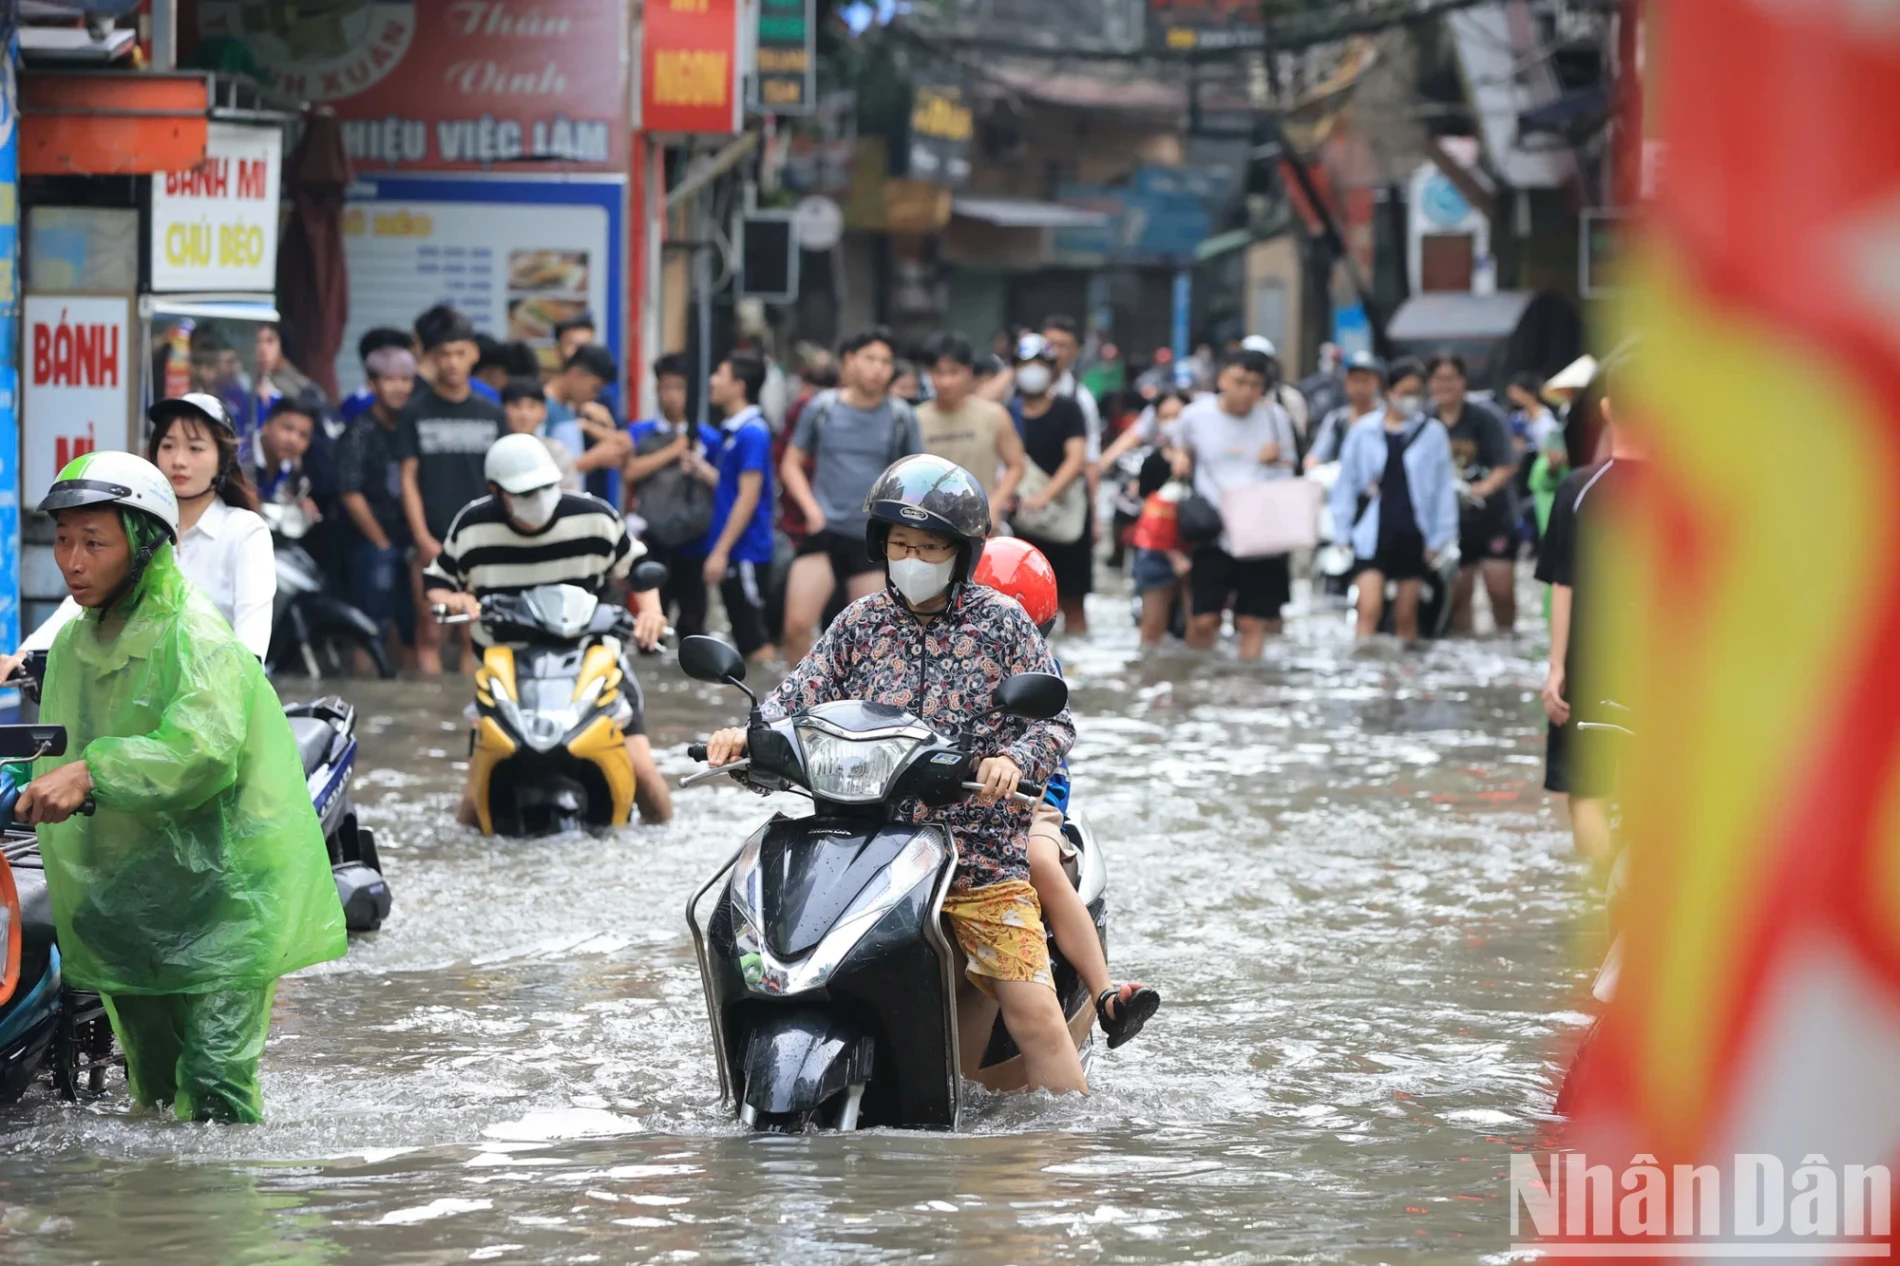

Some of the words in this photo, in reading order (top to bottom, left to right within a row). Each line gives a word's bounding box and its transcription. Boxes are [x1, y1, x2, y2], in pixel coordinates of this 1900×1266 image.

[341, 114, 428, 167] HIỆU
[437, 114, 522, 169] VIỆC
[33, 307, 119, 387] BÁNH
